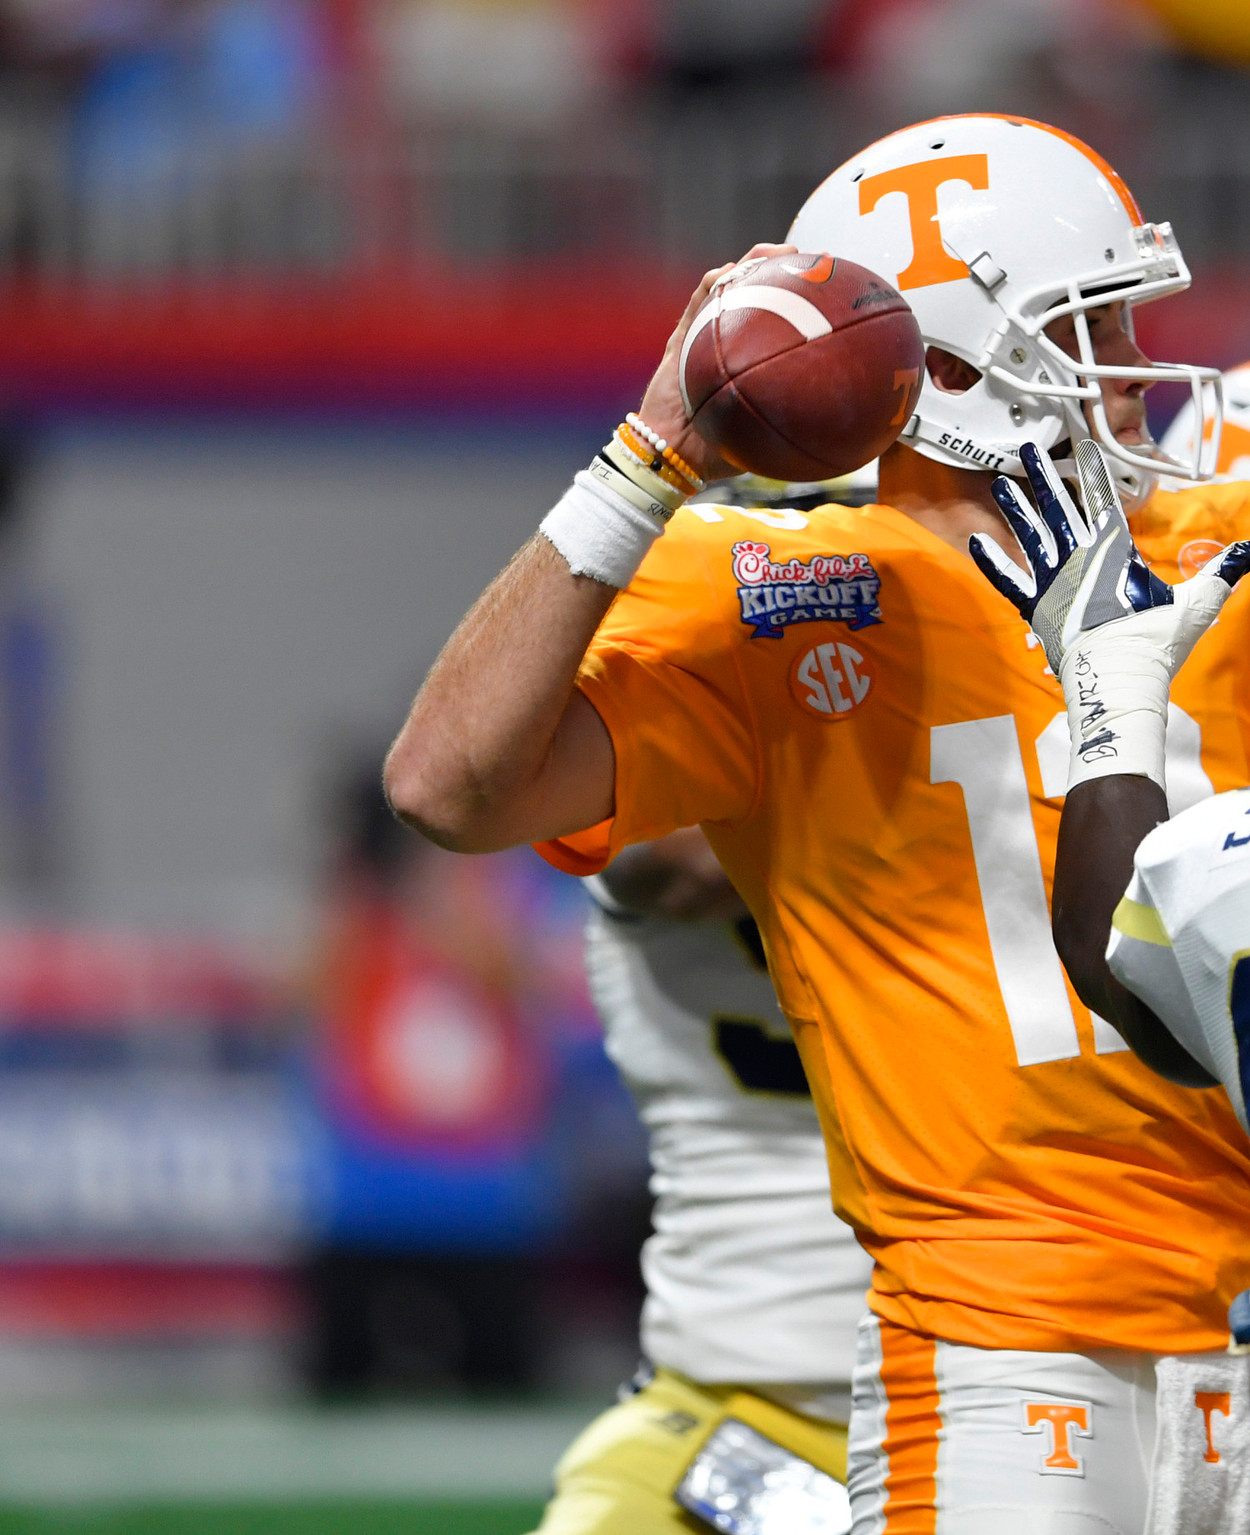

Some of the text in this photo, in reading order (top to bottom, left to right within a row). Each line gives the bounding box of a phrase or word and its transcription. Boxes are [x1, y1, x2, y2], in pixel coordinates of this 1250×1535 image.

[858, 153, 989, 291] T
[938, 432, 1005, 470] schutt
[737, 551, 874, 584] Chick-fil-A
[739, 579, 880, 618] KICKOFF
[770, 608, 857, 625] GAME
[797, 642, 870, 713] SEC
[1022, 1401, 1093, 1476] T
[1195, 1392, 1230, 1463] T
